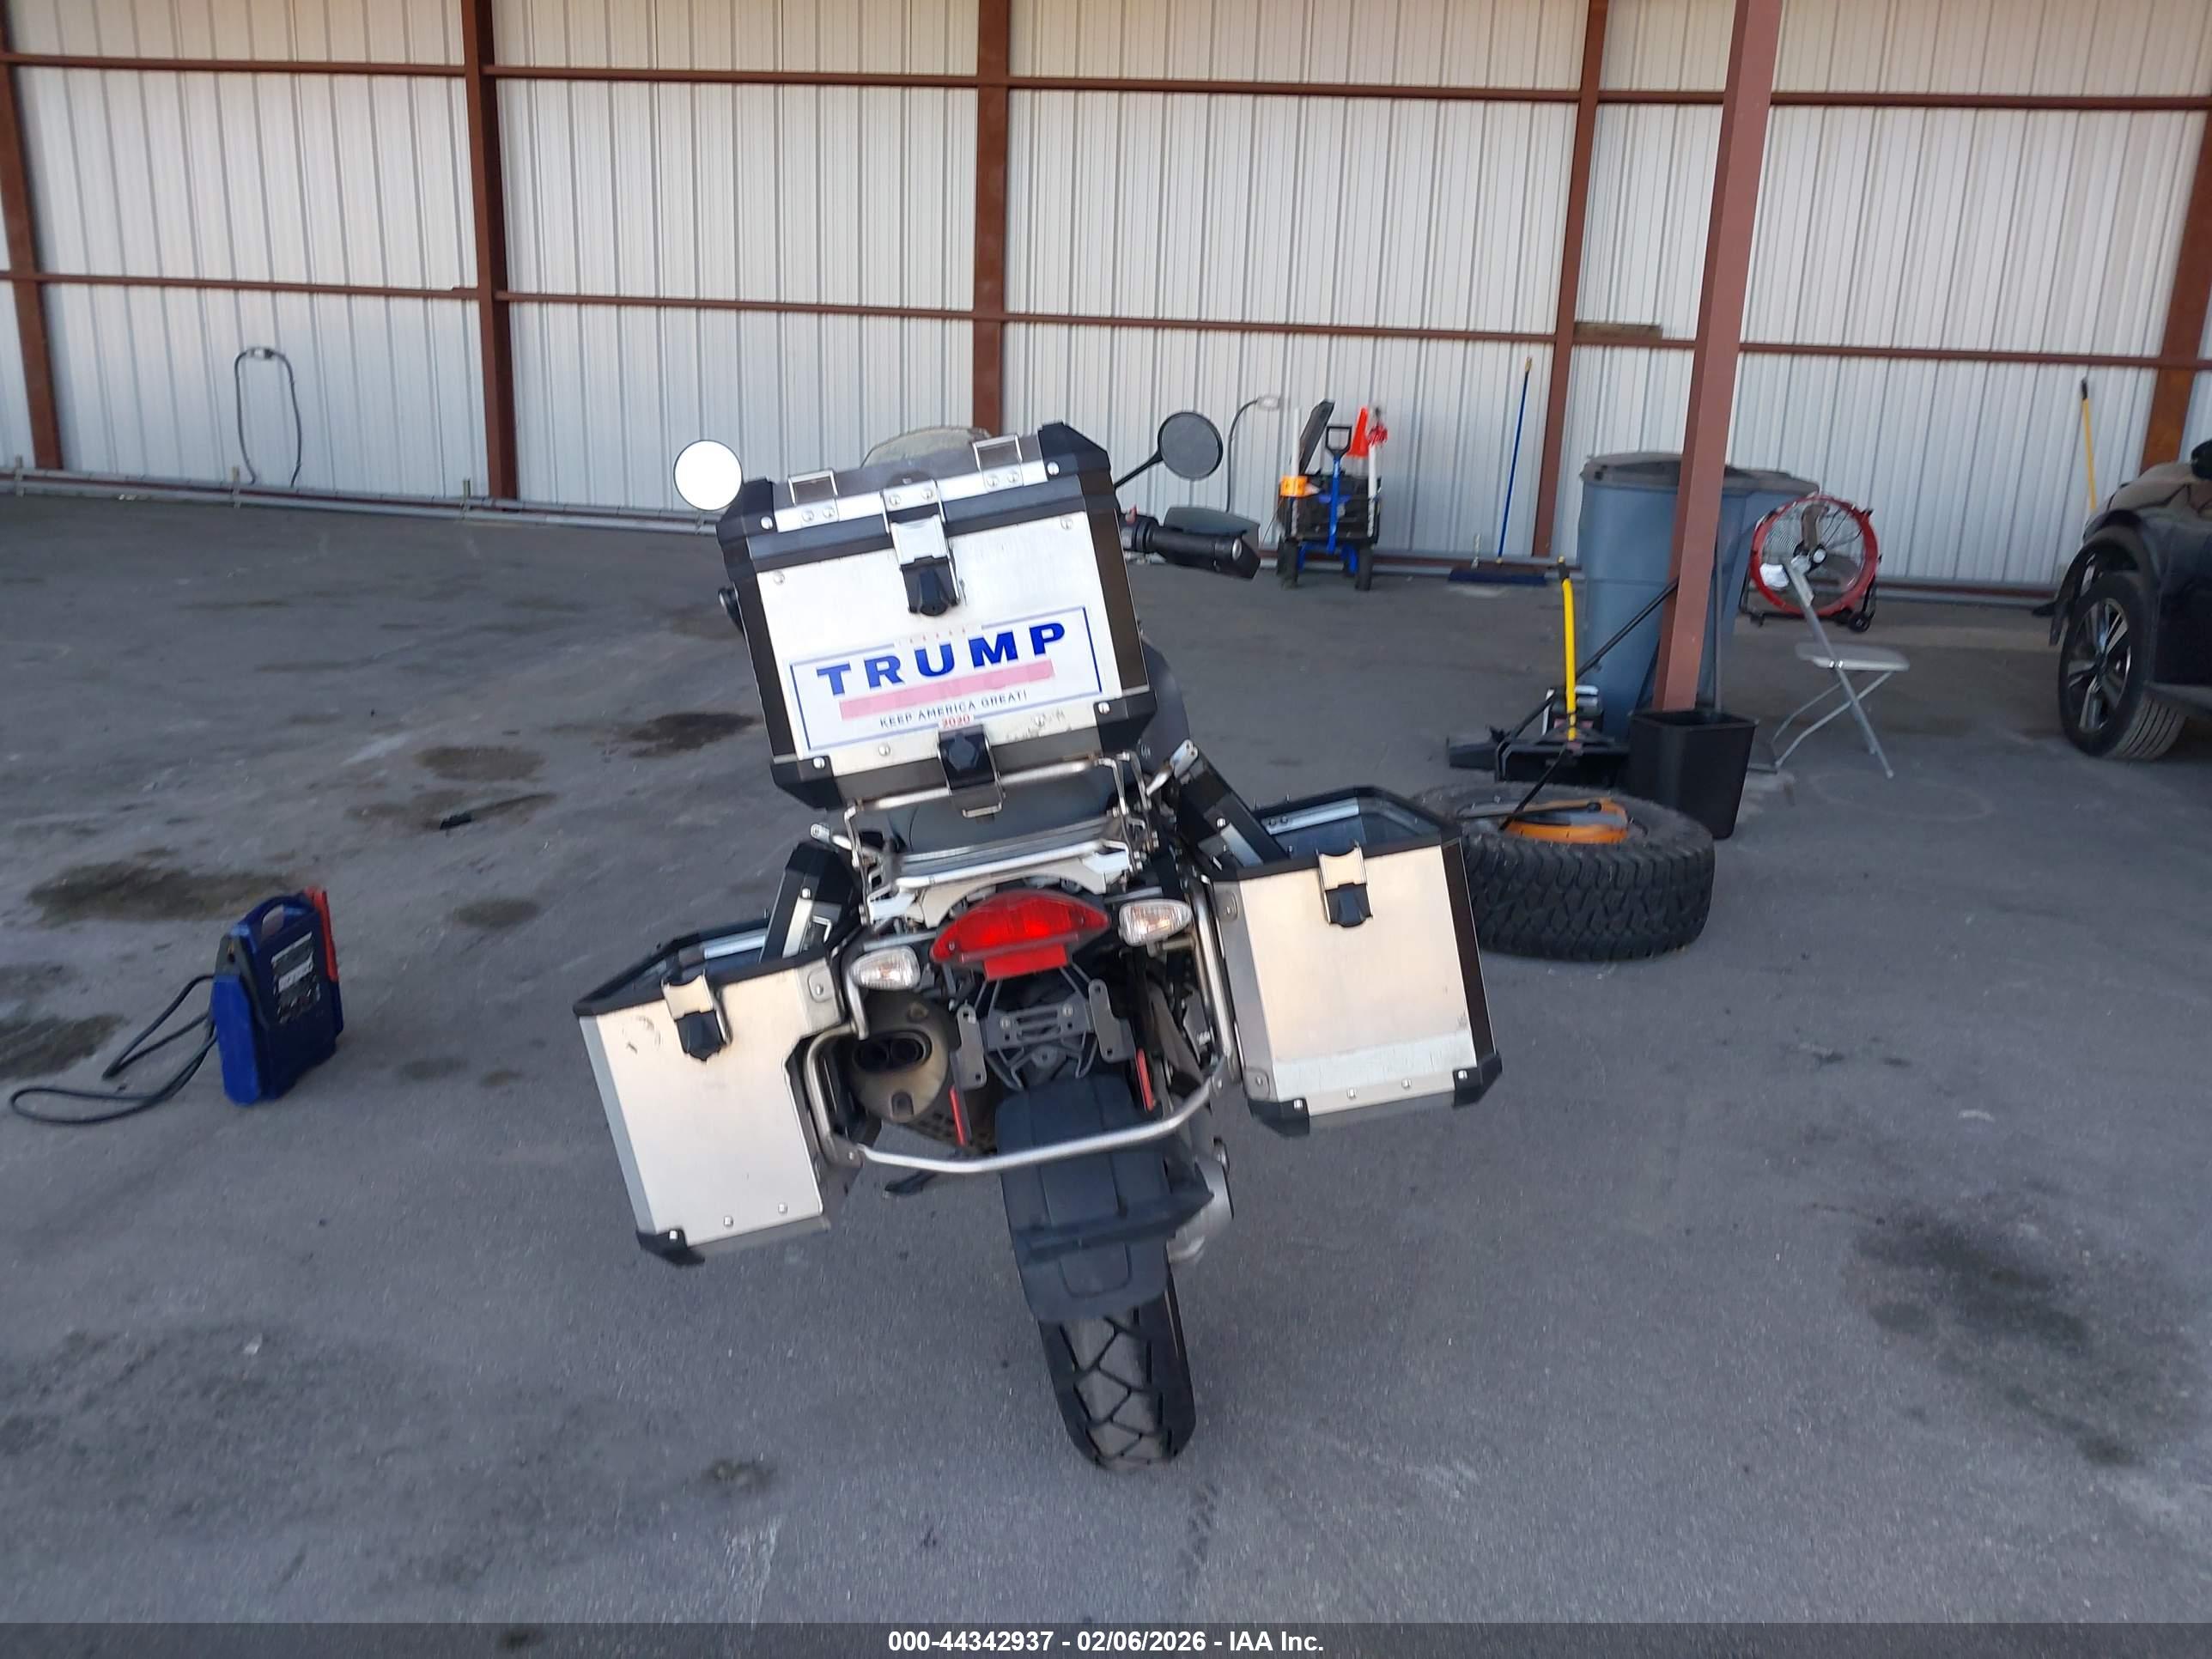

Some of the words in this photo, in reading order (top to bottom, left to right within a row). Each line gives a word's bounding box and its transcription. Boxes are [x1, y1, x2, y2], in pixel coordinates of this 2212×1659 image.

[817, 623, 1065, 696] TRUMP
[879, 714, 913, 728] KEEP
[918, 700, 976, 720] AMERICA
[981, 690, 1028, 708] GREAT!
[943, 714, 971, 728] 2020
